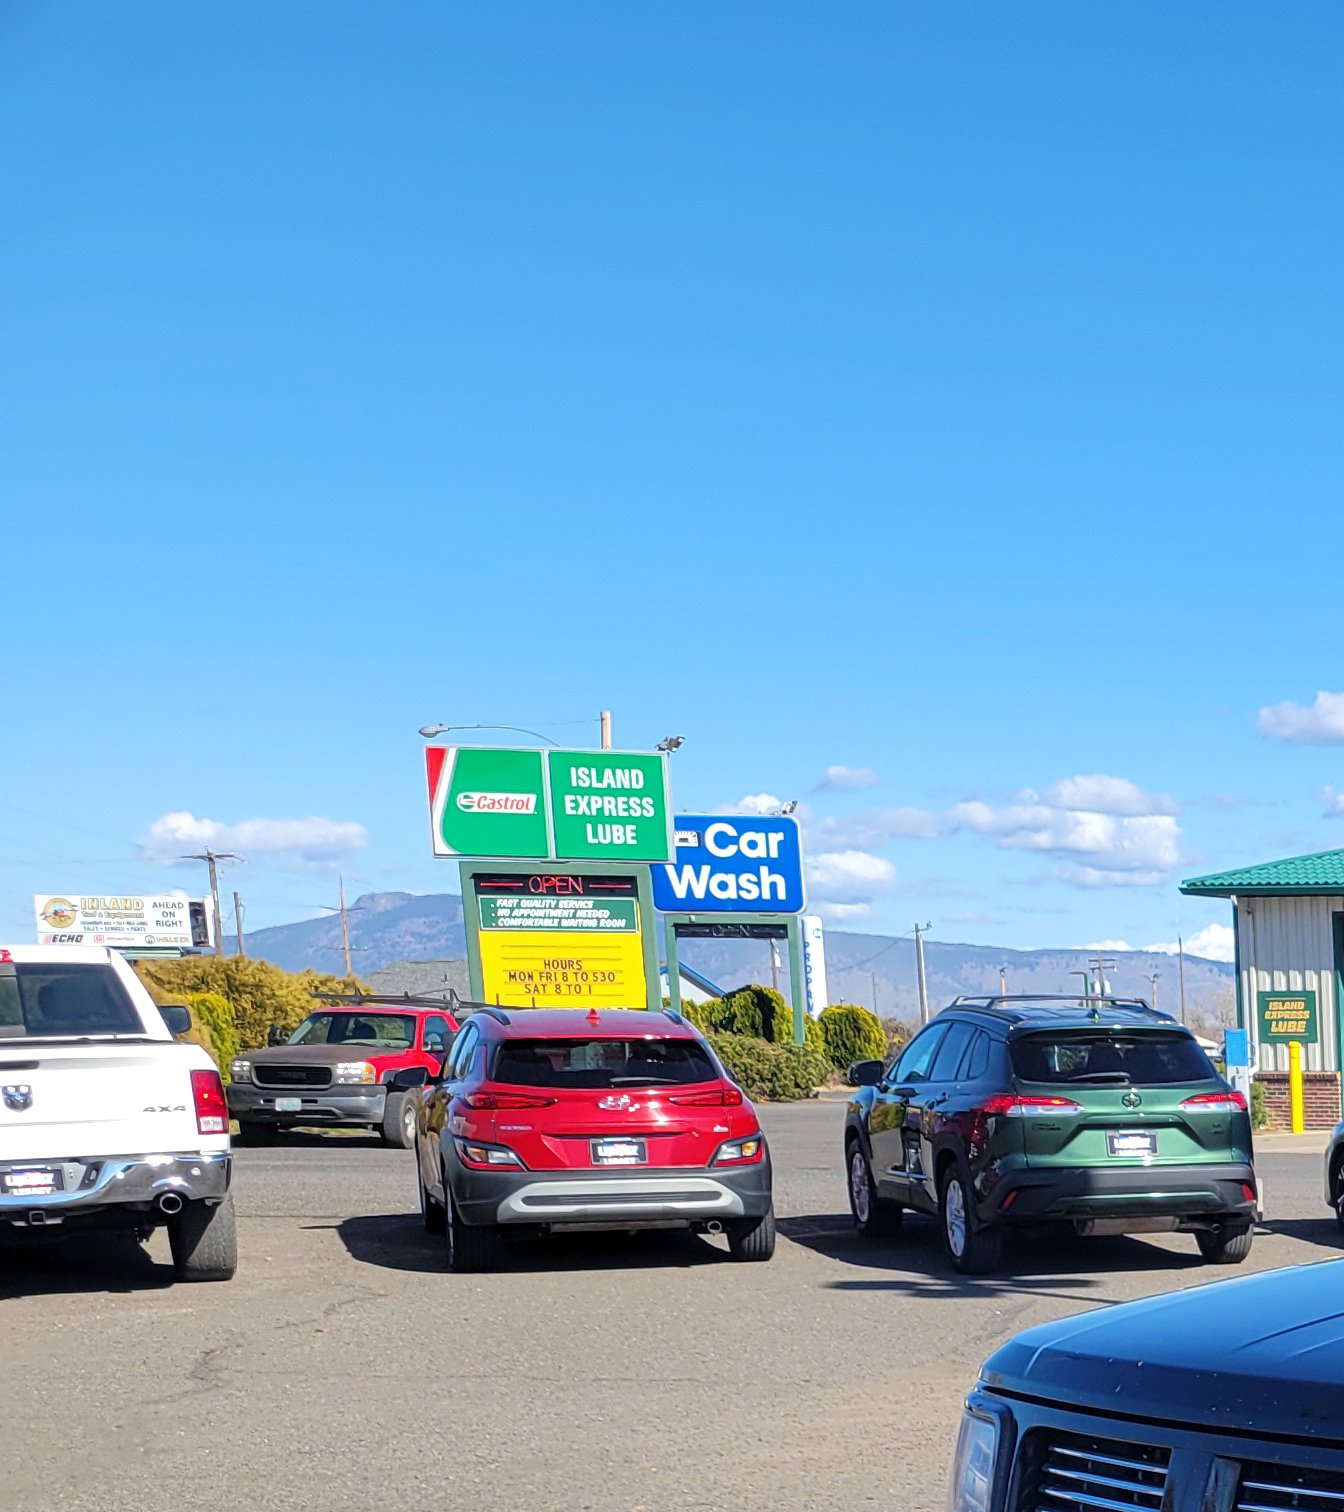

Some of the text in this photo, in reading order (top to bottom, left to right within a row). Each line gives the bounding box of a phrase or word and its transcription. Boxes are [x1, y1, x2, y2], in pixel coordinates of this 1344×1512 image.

[569, 766, 645, 790] ISLAND
[476, 795, 531, 811] Castrol
[564, 794, 655, 818] EXPRESS
[586, 823, 638, 845] LUBE
[704, 822, 785, 859] Car
[528, 875, 584, 895] OPEN
[665, 864, 787, 901] Wash
[80, 897, 145, 911] INLAND
[152, 901, 184, 910] AHEAD
[496, 898, 594, 909] FAST QUALITY SERVICE
[161, 910, 176, 919] ON
[497, 908, 611, 919] NO APPOINTMENT NEEDED
[155, 919, 184, 929] RIGHT
[497, 917, 627, 928] COMFORTABLE WAITING ROOM
[51, 934, 84, 944] ECHO
[543, 959, 583, 971] HOURS
[508, 971, 616, 983] MON FRI 8 TO 530
[524, 983, 548, 995] SAT
[554, 983, 562, 995] 8
[567, 983, 582, 995] TO
[1268, 1001, 1305, 1011] ISLAND
[1264, 1010, 1310, 1020] EXPRESS
[1270, 1020, 1307, 1033] LUBE
